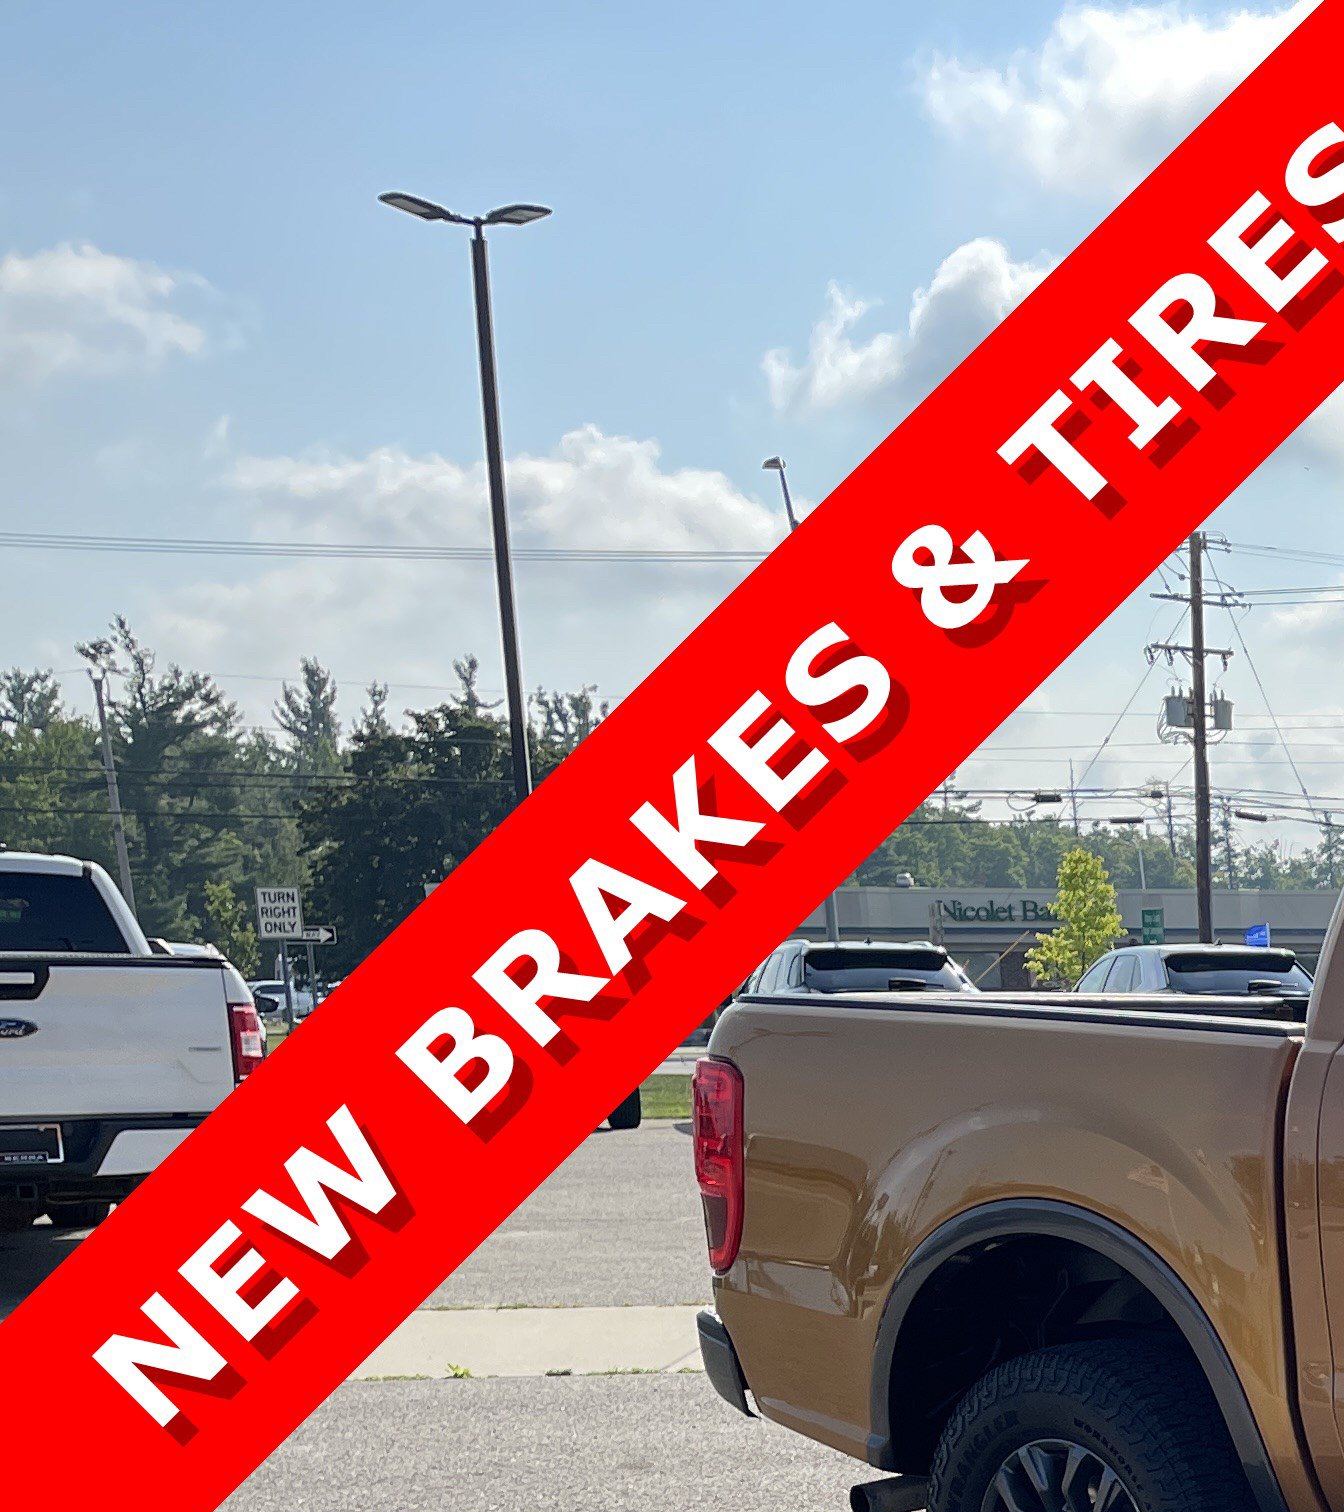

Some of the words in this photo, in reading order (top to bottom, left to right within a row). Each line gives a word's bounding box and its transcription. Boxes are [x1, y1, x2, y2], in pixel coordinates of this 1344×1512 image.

[261, 891, 295, 903] TURN
[260, 906, 297, 919] RIGHT
[937, 900, 1015, 921] Nicolet
[1020, 900, 1058, 921] Ba
[264, 921, 297, 934] ONLY
